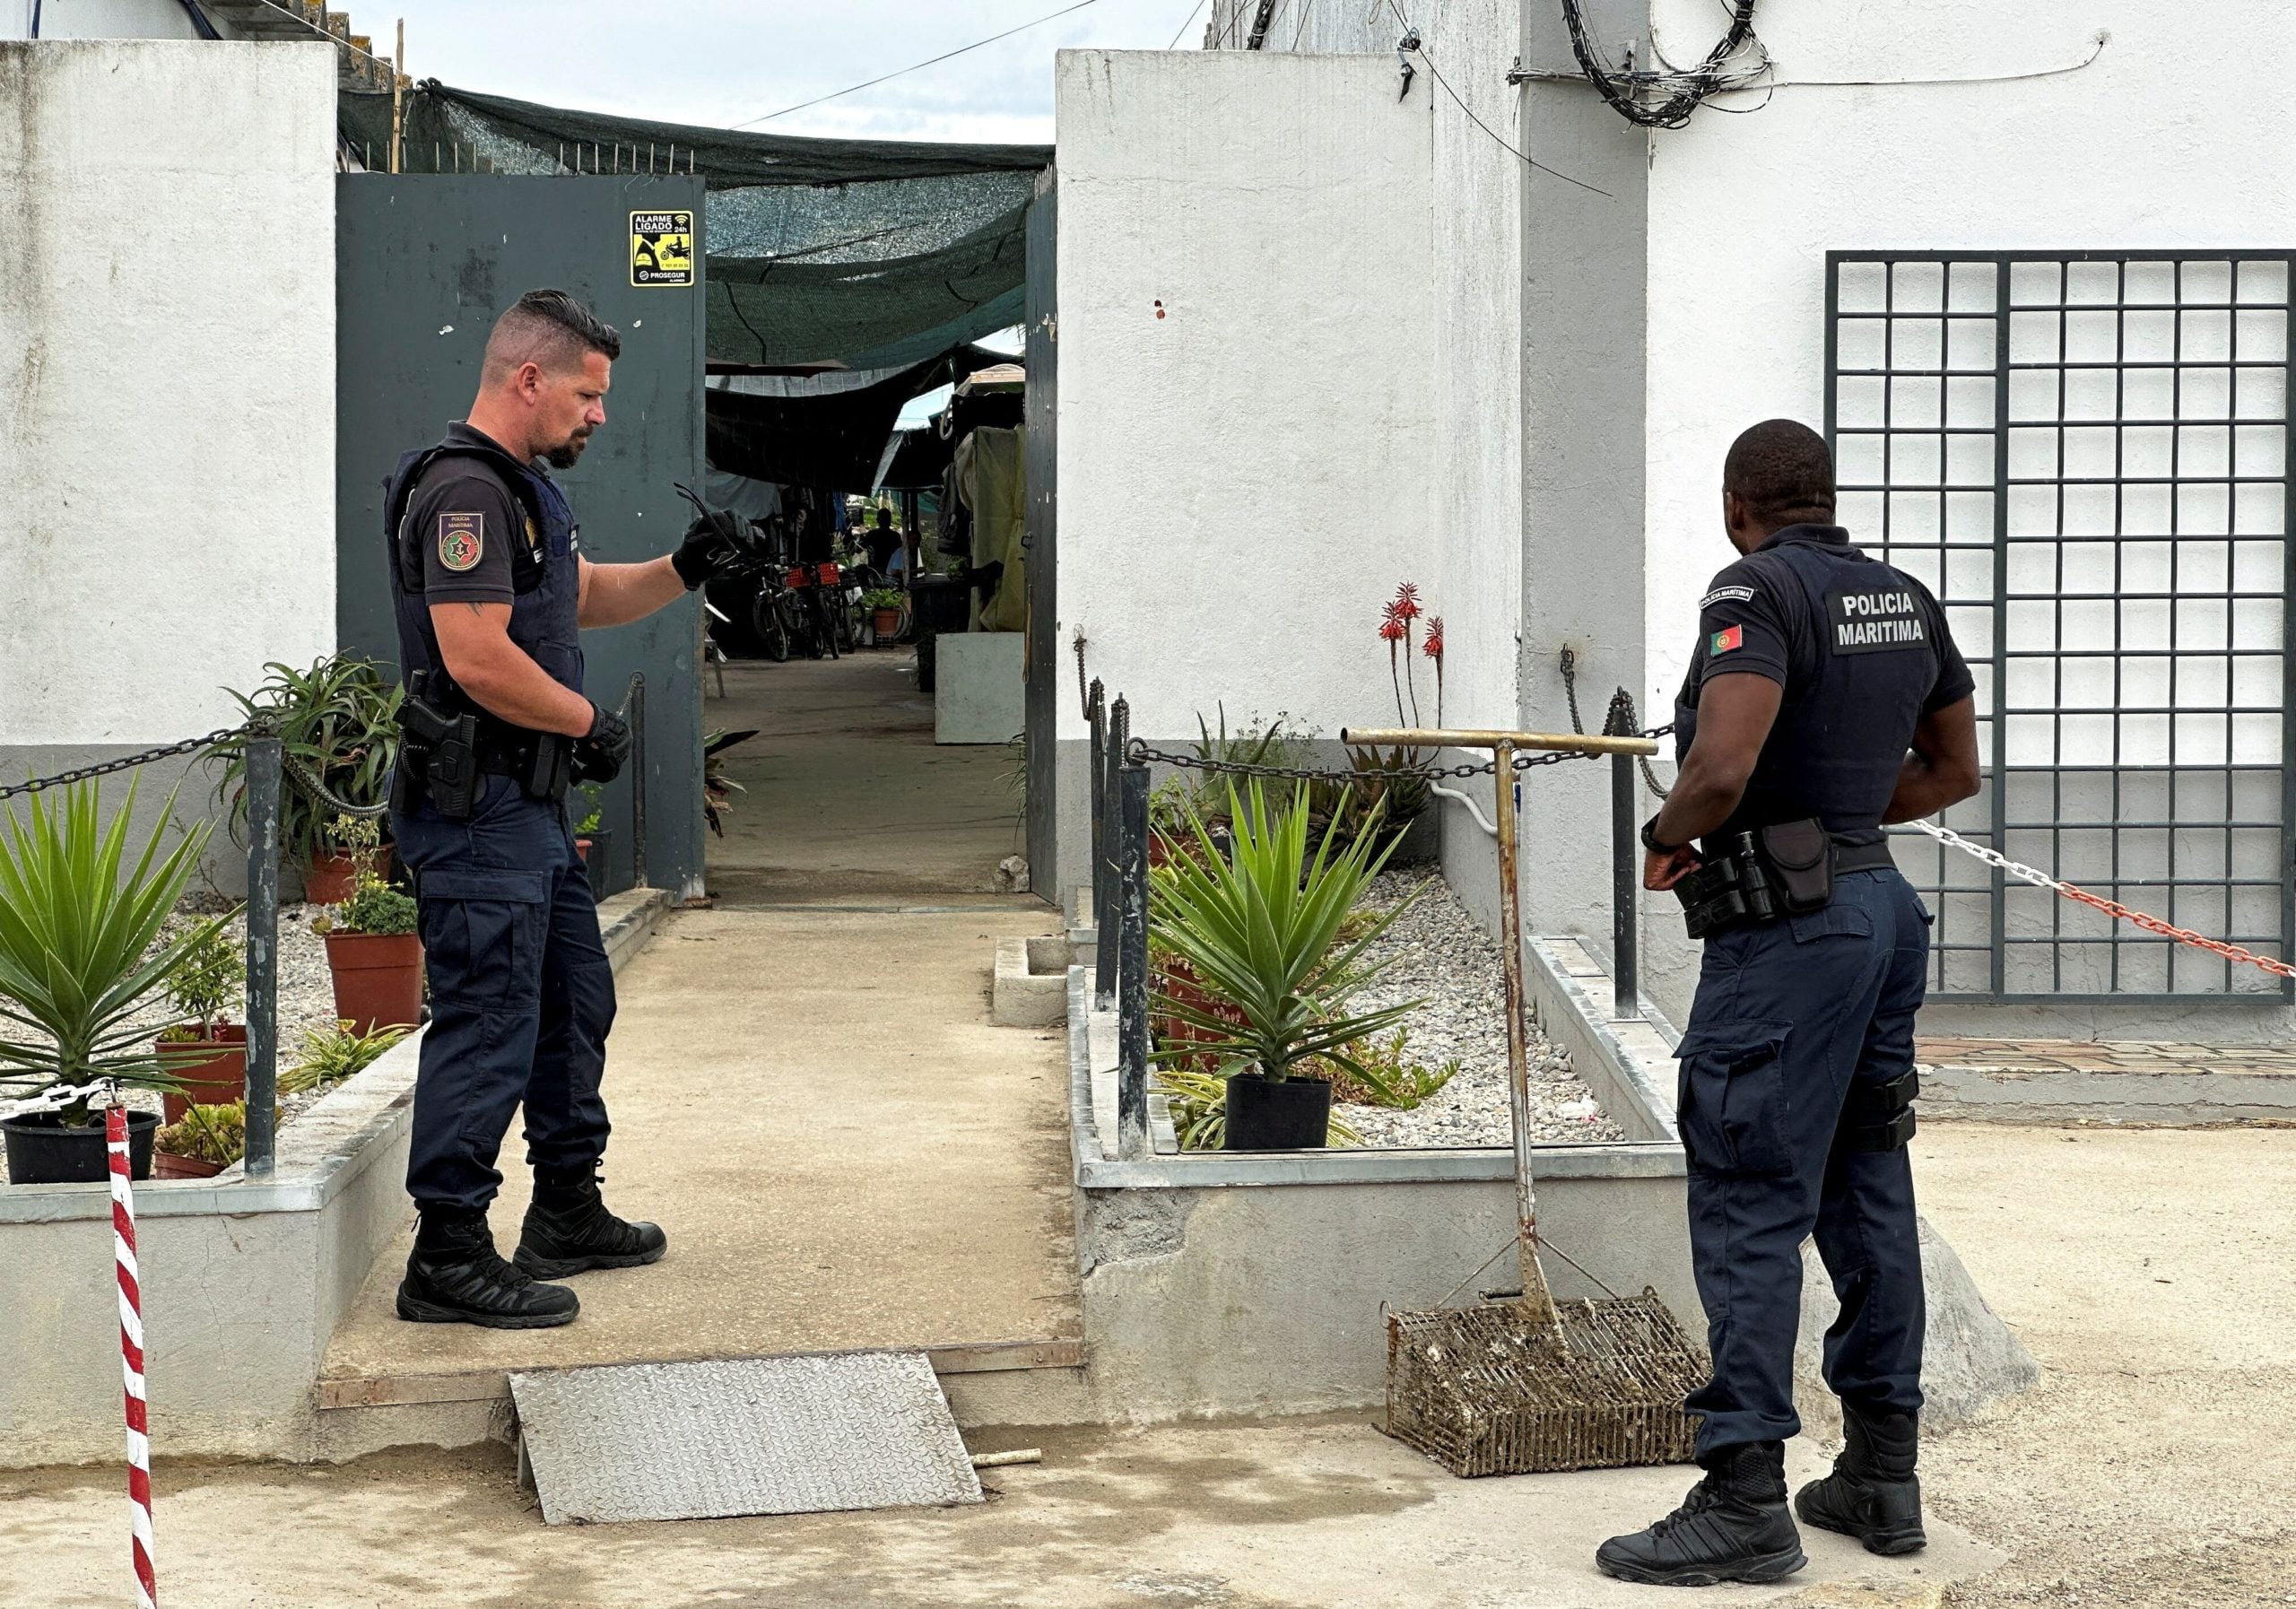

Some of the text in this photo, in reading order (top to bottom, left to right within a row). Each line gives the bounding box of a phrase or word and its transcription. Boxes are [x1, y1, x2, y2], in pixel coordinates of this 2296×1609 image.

[635, 222, 673, 230] LIGADO
[1842, 592, 1914, 616] POLICIA
[1838, 619, 1924, 646] MARITIMA
